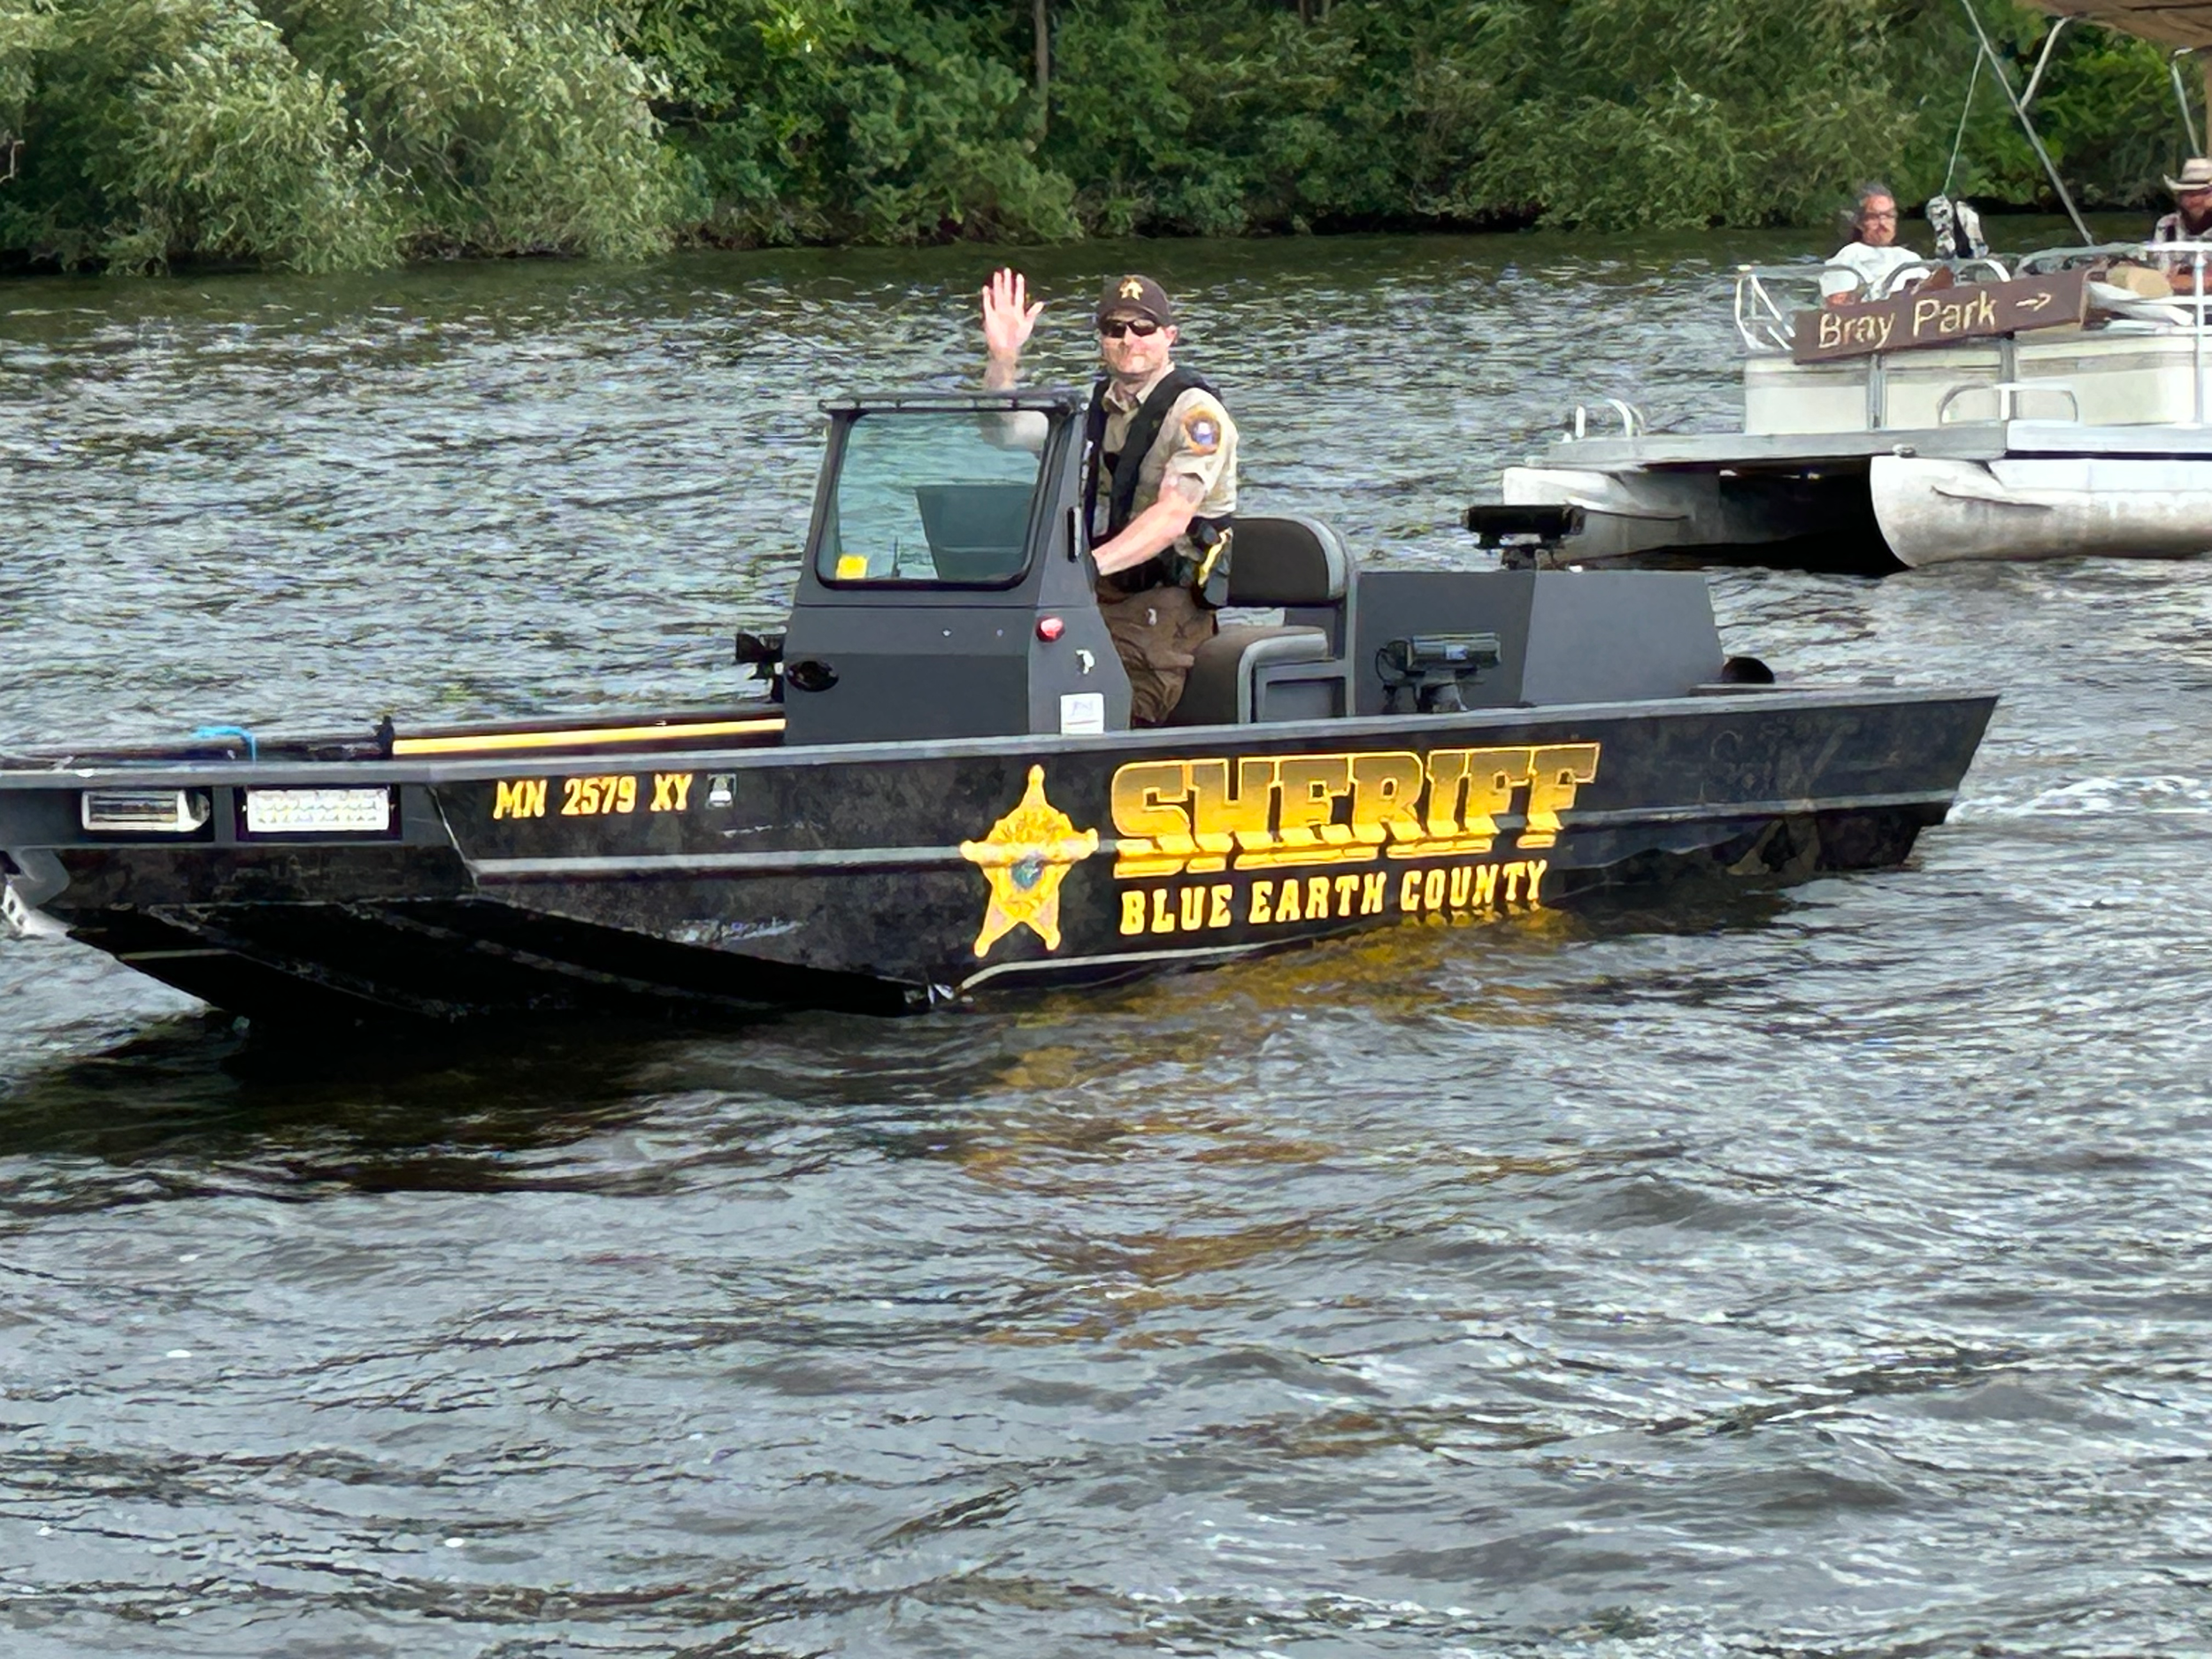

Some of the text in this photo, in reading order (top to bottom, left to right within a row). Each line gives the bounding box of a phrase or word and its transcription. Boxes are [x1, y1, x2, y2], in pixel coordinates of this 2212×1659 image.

[1818, 291, 1997, 349] Bray Park
[493, 773, 693, 819] MN 2579 XY
[1112, 743, 1601, 878] SHERIFF
[1119, 860, 1548, 934] BLUE EARTH COUNTY
